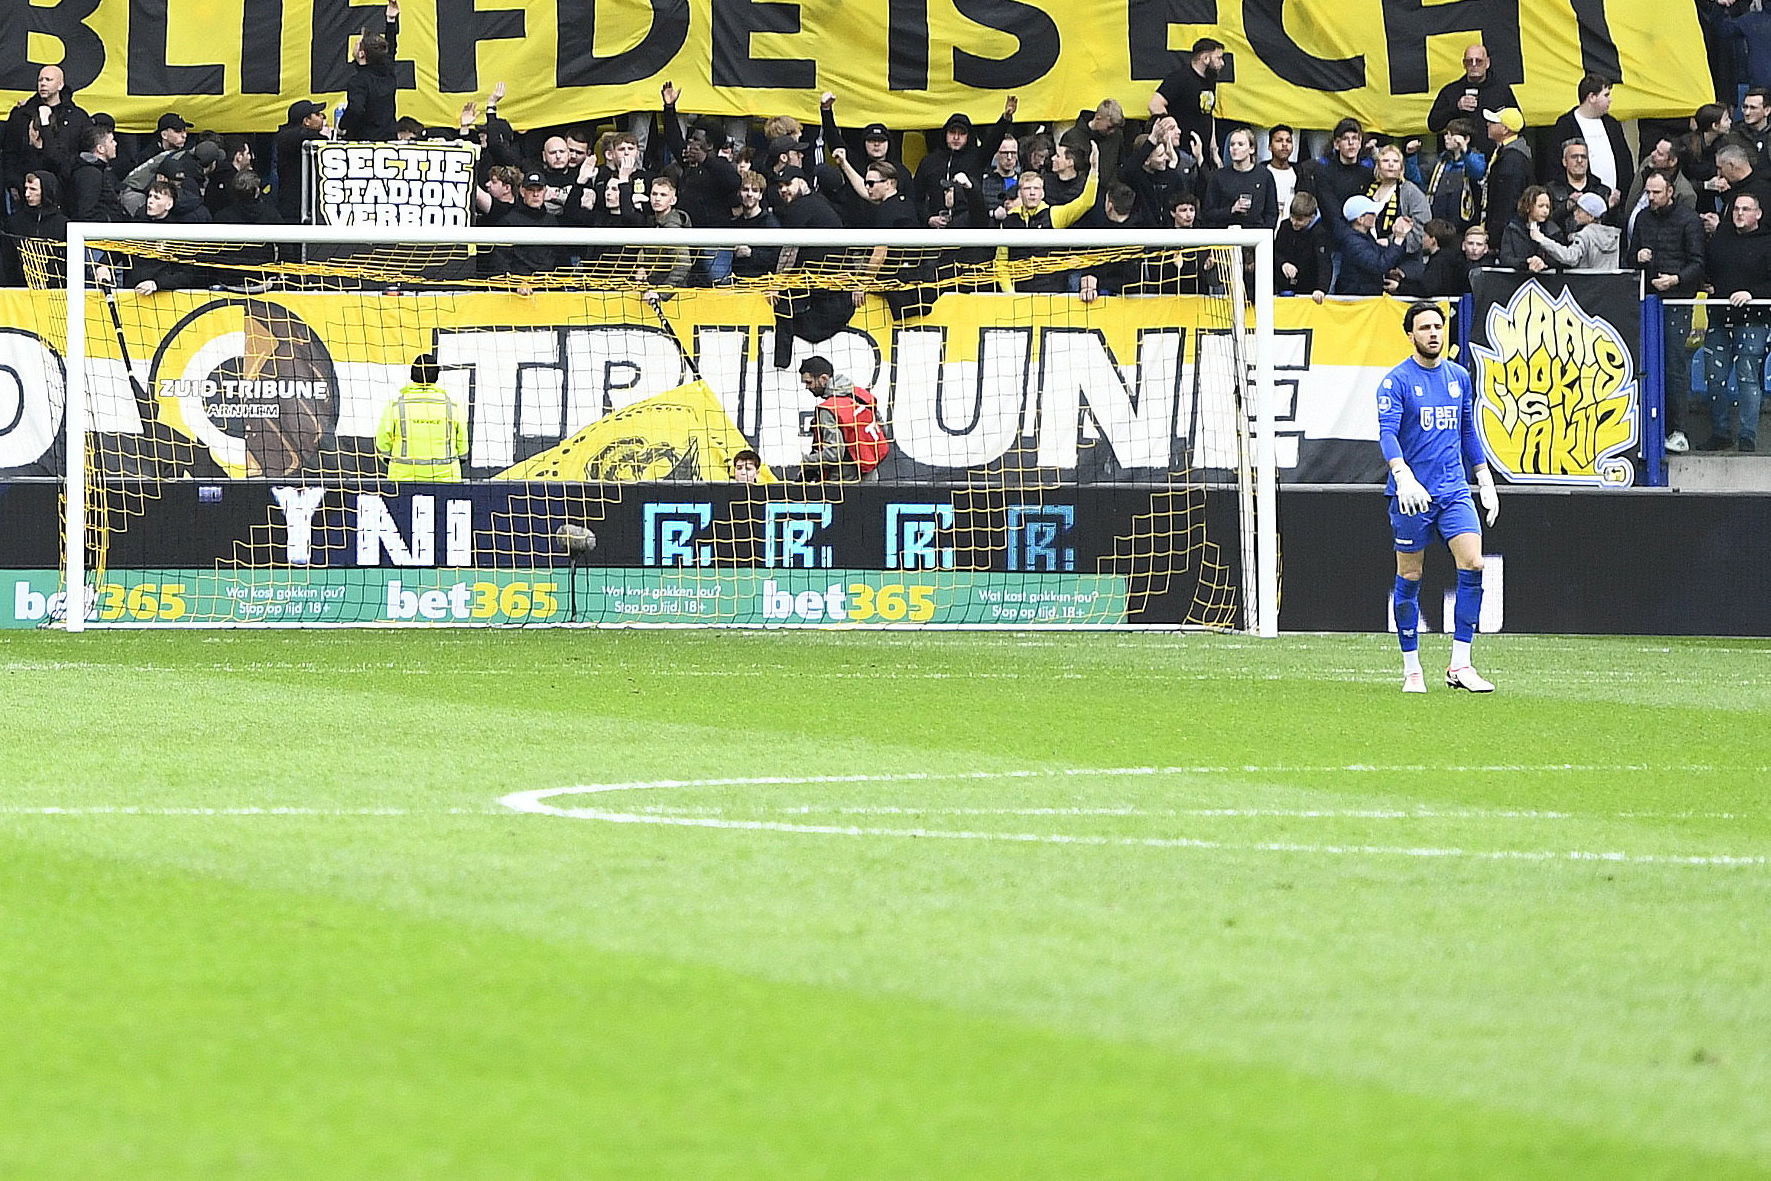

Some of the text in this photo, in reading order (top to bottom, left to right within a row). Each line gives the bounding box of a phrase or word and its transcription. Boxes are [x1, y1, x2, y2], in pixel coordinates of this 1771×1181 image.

[321, 148, 472, 182] SECTIE
[323, 179, 468, 207] STADION
[325, 203, 468, 227] VERBOD
[159, 379, 328, 399] ZUID TRIBUNE
[207, 404, 279, 419] ARNHEM
[1435, 406, 1458, 419] BET
[226, 586, 248, 598] Wat
[387, 580, 558, 619] bet365
[762, 580, 936, 621] bet365
[979, 589, 1001, 601] Wat
[1004, 590, 1026, 602] kost
[643, 603, 657, 614] op
[685, 601, 707, 612] 18+
[992, 605, 1017, 618] Stop
[1020, 607, 1034, 619] op
